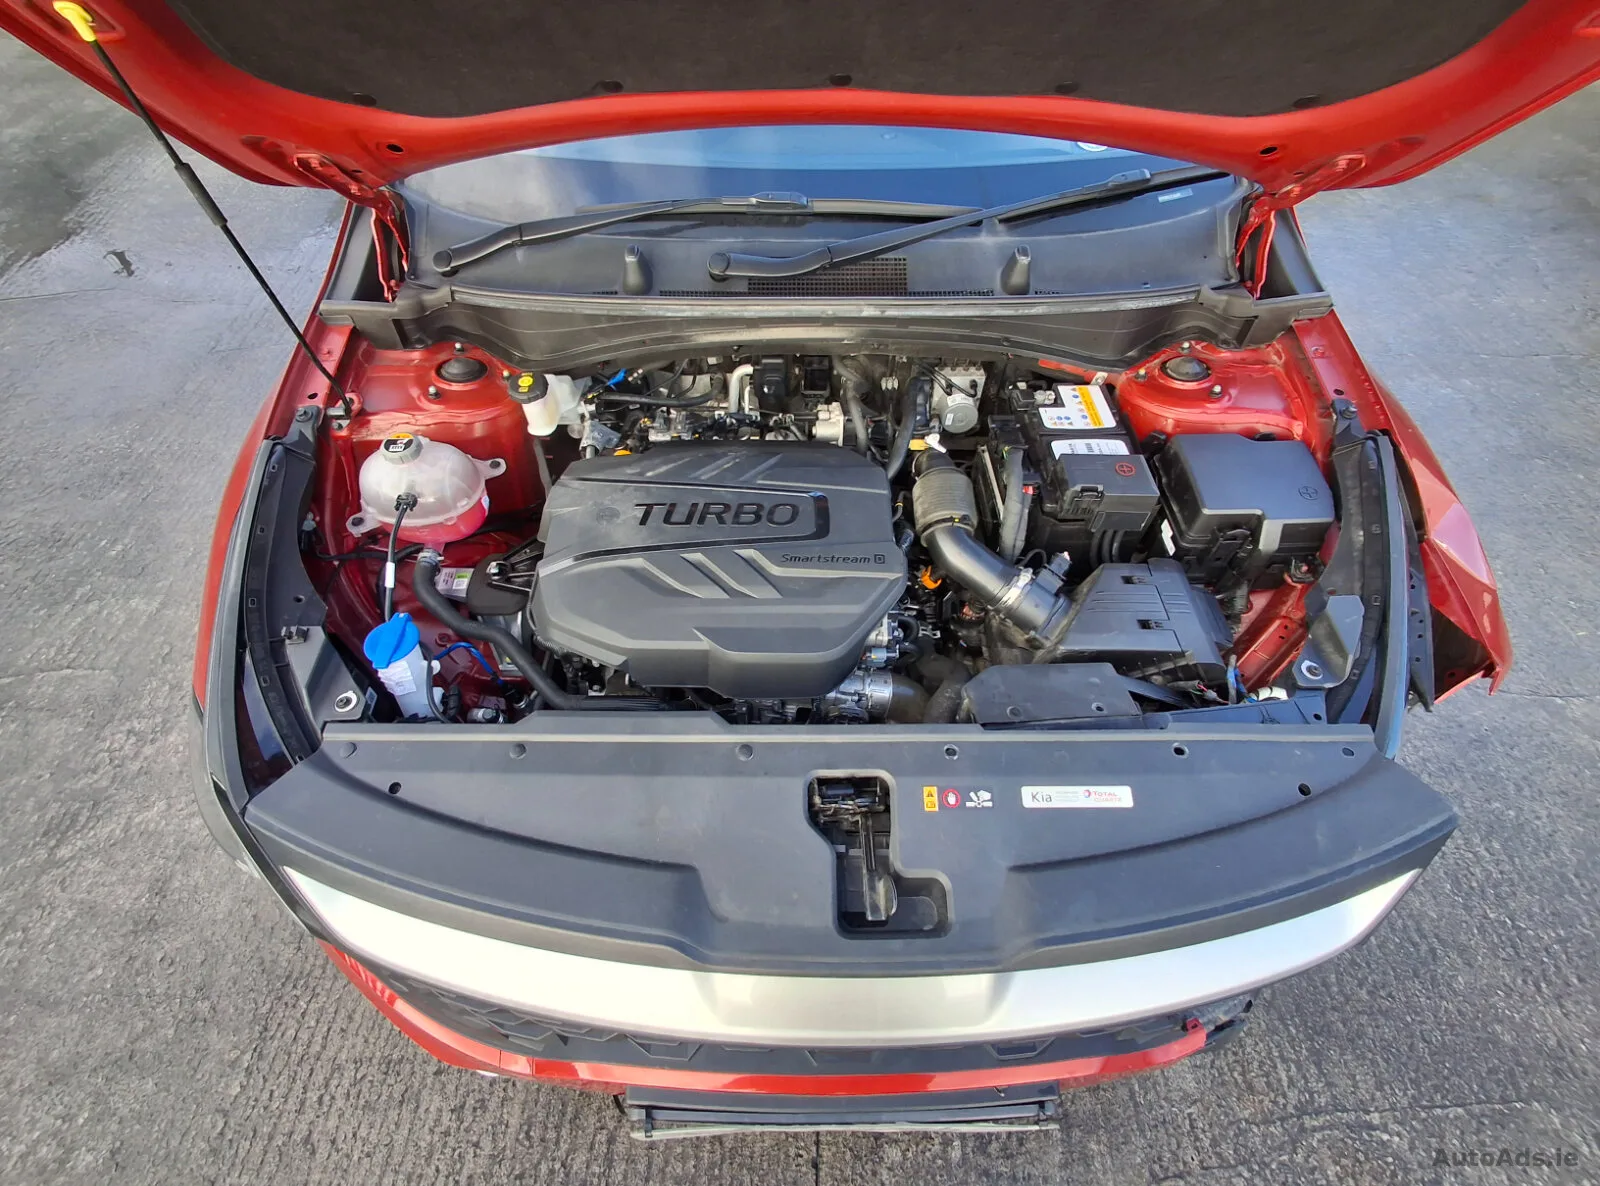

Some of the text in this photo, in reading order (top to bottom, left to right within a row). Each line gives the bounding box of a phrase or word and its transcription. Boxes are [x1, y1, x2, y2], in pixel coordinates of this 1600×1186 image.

[633, 502, 800, 527] TURBO
[780, 552, 871, 565] Smartstream
[1030, 791, 1053, 803] Kia
